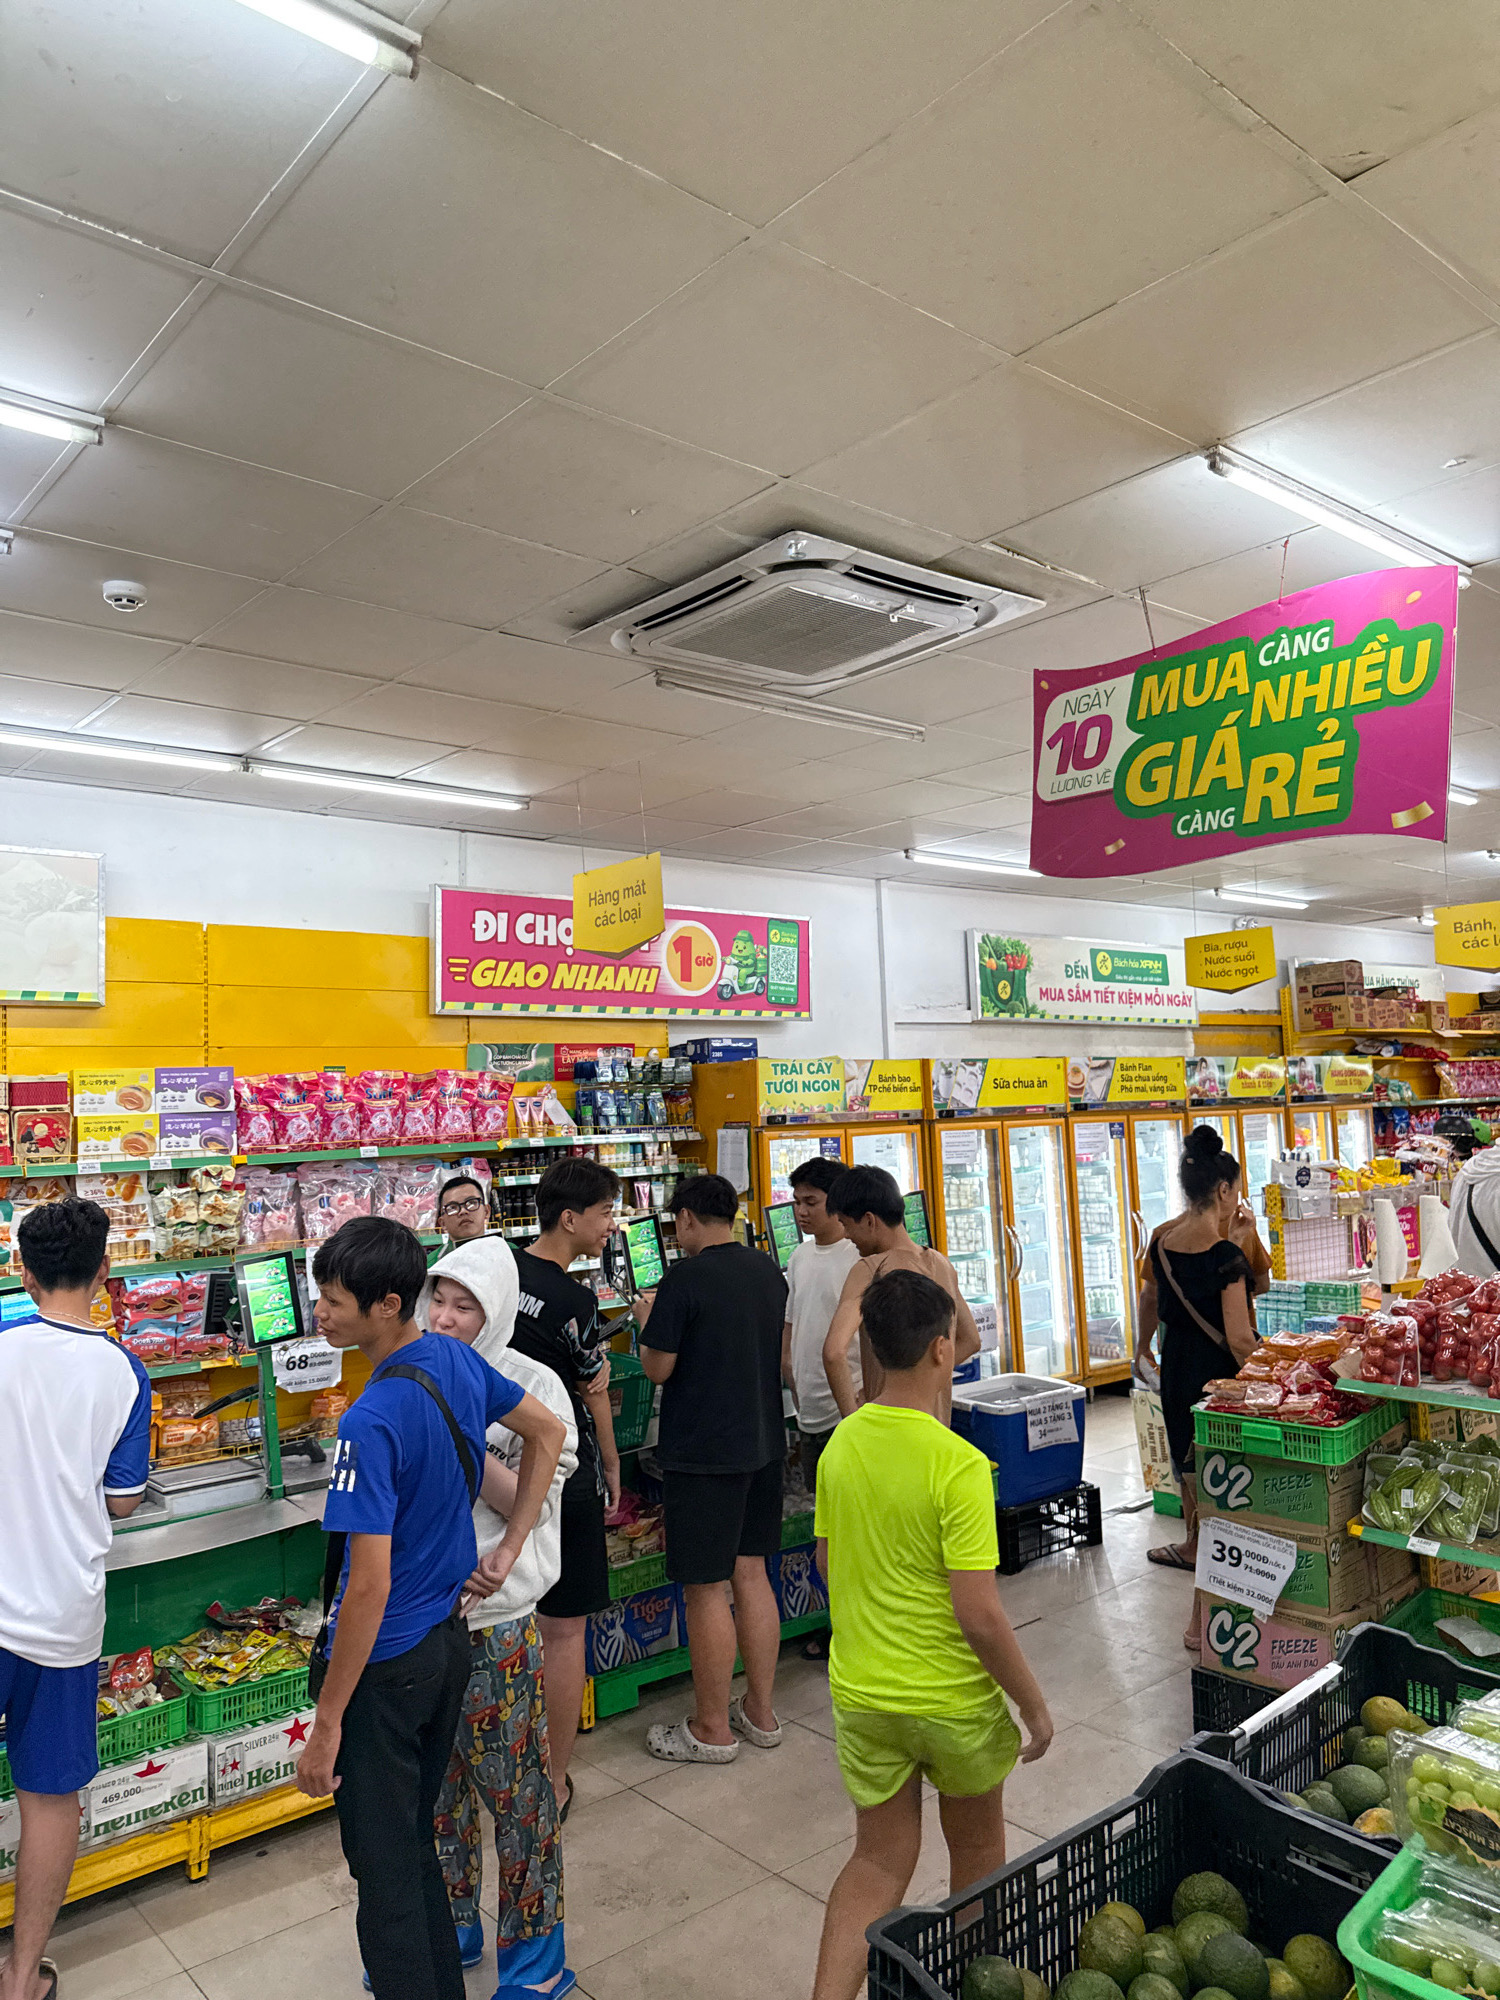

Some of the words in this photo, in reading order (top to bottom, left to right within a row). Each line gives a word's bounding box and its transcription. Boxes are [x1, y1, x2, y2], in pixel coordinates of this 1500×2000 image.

[1258, 626, 1332, 667] CÀNG
[1136, 650, 1250, 722] MUA
[1250, 633, 1432, 729] NHIỀU
[1063, 686, 1116, 718] NGÀY
[1046, 714, 1113, 776] 10
[1125, 710, 1244, 808] GIÁ
[1242, 718, 1346, 825] RẺ
[1176, 807, 1236, 836] CÀNG
[588, 887, 620, 909] Hàng
[623, 880, 647, 898] mát
[472, 911, 508, 943] ĐI
[595, 911, 616, 928] các
[619, 906, 642, 925] loại
[1453, 918, 1497, 934] Bánh,
[1224, 941, 1248, 951] rượu
[1462, 936, 1489, 949] các
[671, 936, 693, 983] 1
[695, 954, 714, 968] GIỜ
[1204, 955, 1231, 966] Nước
[1234, 950, 1255, 963] suối
[470, 961, 549, 989] GIAO
[551, 964, 661, 994] NHANH
[1065, 959, 1089, 979] ĐẾN
[1205, 968, 1233, 979] Nước
[1235, 965, 1259, 978] ngọt
[1039, 987, 1065, 1002] MUA
[1068, 983, 1092, 1003] SẮM
[1094, 986, 1115, 1004] TIẾT
[1118, 988, 1142, 1009] KIỆM
[1145, 987, 1165, 1007] MỖI
[1167, 990, 1193, 1008] NGÀY
[771, 1061, 803, 1076] TRÁI
[807, 1060, 833, 1075] CÂY
[1120, 1063, 1137, 1072] Bánh
[1138, 1063, 1152, 1071] Flan
[765, 1079, 798, 1094] TƯƠI
[802, 1079, 840, 1093] NGON
[878, 1074, 896, 1083] Bánh
[898, 1075, 911, 1083] bao
[993, 1077, 1010, 1090] Sữa
[1013, 1077, 1035, 1089] chua
[1037, 1077, 1048, 1089] ăn
[1120, 1074, 1133, 1082] Sữa
[1134, 1074, 1150, 1082] chua
[1152, 1072, 1168, 1084] uống
[280, 1090, 309, 1105] Surf
[325, 1090, 344, 1103] Su
[365, 1088, 394, 1100] Surf
[286, 1355, 309, 1371] 68
[1028, 1406, 1041, 1416] MUA
[1043, 1406, 1047, 1414] 2
[1030, 1418, 1043, 1428] MUA
[1067, 1412, 1072, 1420] 3
[1202, 1454, 1251, 1509] C2
[1263, 1472, 1313, 1493] FREEZE
[1211, 1539, 1242, 1568] 39
[1330, 1542, 1341, 1563] C2
[1227, 1581, 1245, 1594] kiệm
[630, 1594, 672, 1624] Tiger
[1209, 1610, 1258, 1668] C2
[1271, 1638, 1318, 1656] FREEZE
[244, 1736, 268, 1752] SILVER
[247, 1760, 297, 1791] Hein
[102, 1785, 142, 1805] 469.000
[1444, 1818, 1486, 1846] MUSCAT
